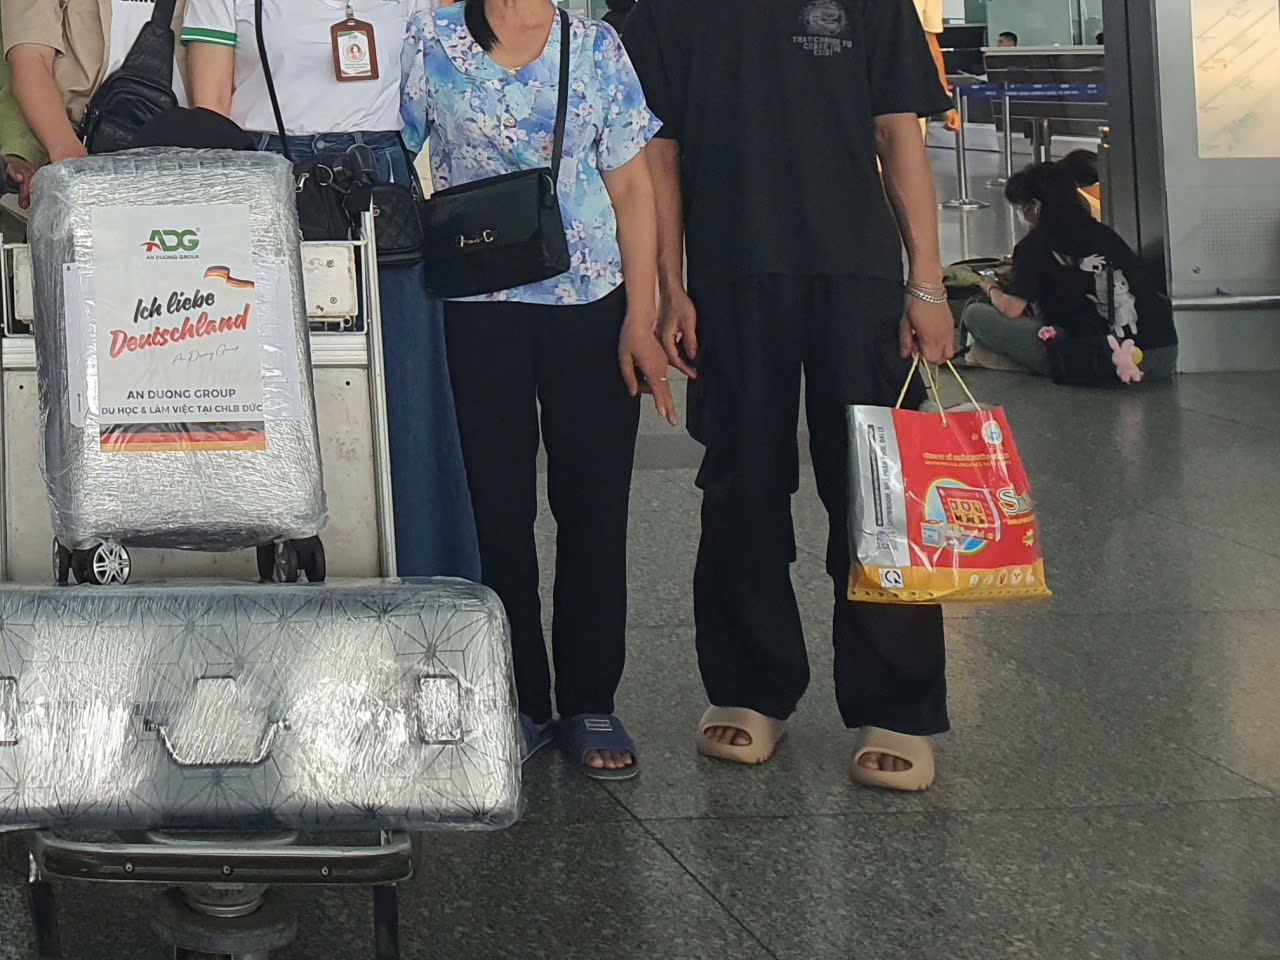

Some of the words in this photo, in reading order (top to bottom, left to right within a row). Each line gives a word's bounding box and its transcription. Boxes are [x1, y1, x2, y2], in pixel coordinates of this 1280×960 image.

[140, 229, 200, 252] ADG
[133, 296, 162, 323] Ich
[167, 289, 215, 314] liebe
[109, 303, 251, 359] Deutschland
[127, 390, 144, 400] AN
[148, 389, 191, 400] DUONG
[194, 388, 236, 398] GROUP
[101, 407, 115, 415] DU
[118, 406, 138, 417] HỌC
[141, 406, 147, 414] &
[150, 404, 170, 414] LÀM
[172, 403, 194, 415] VIỆC
[197, 405, 212, 415] TẠI
[215, 404, 240, 413] CHLB
[242, 402, 263, 412] ĐỨC
